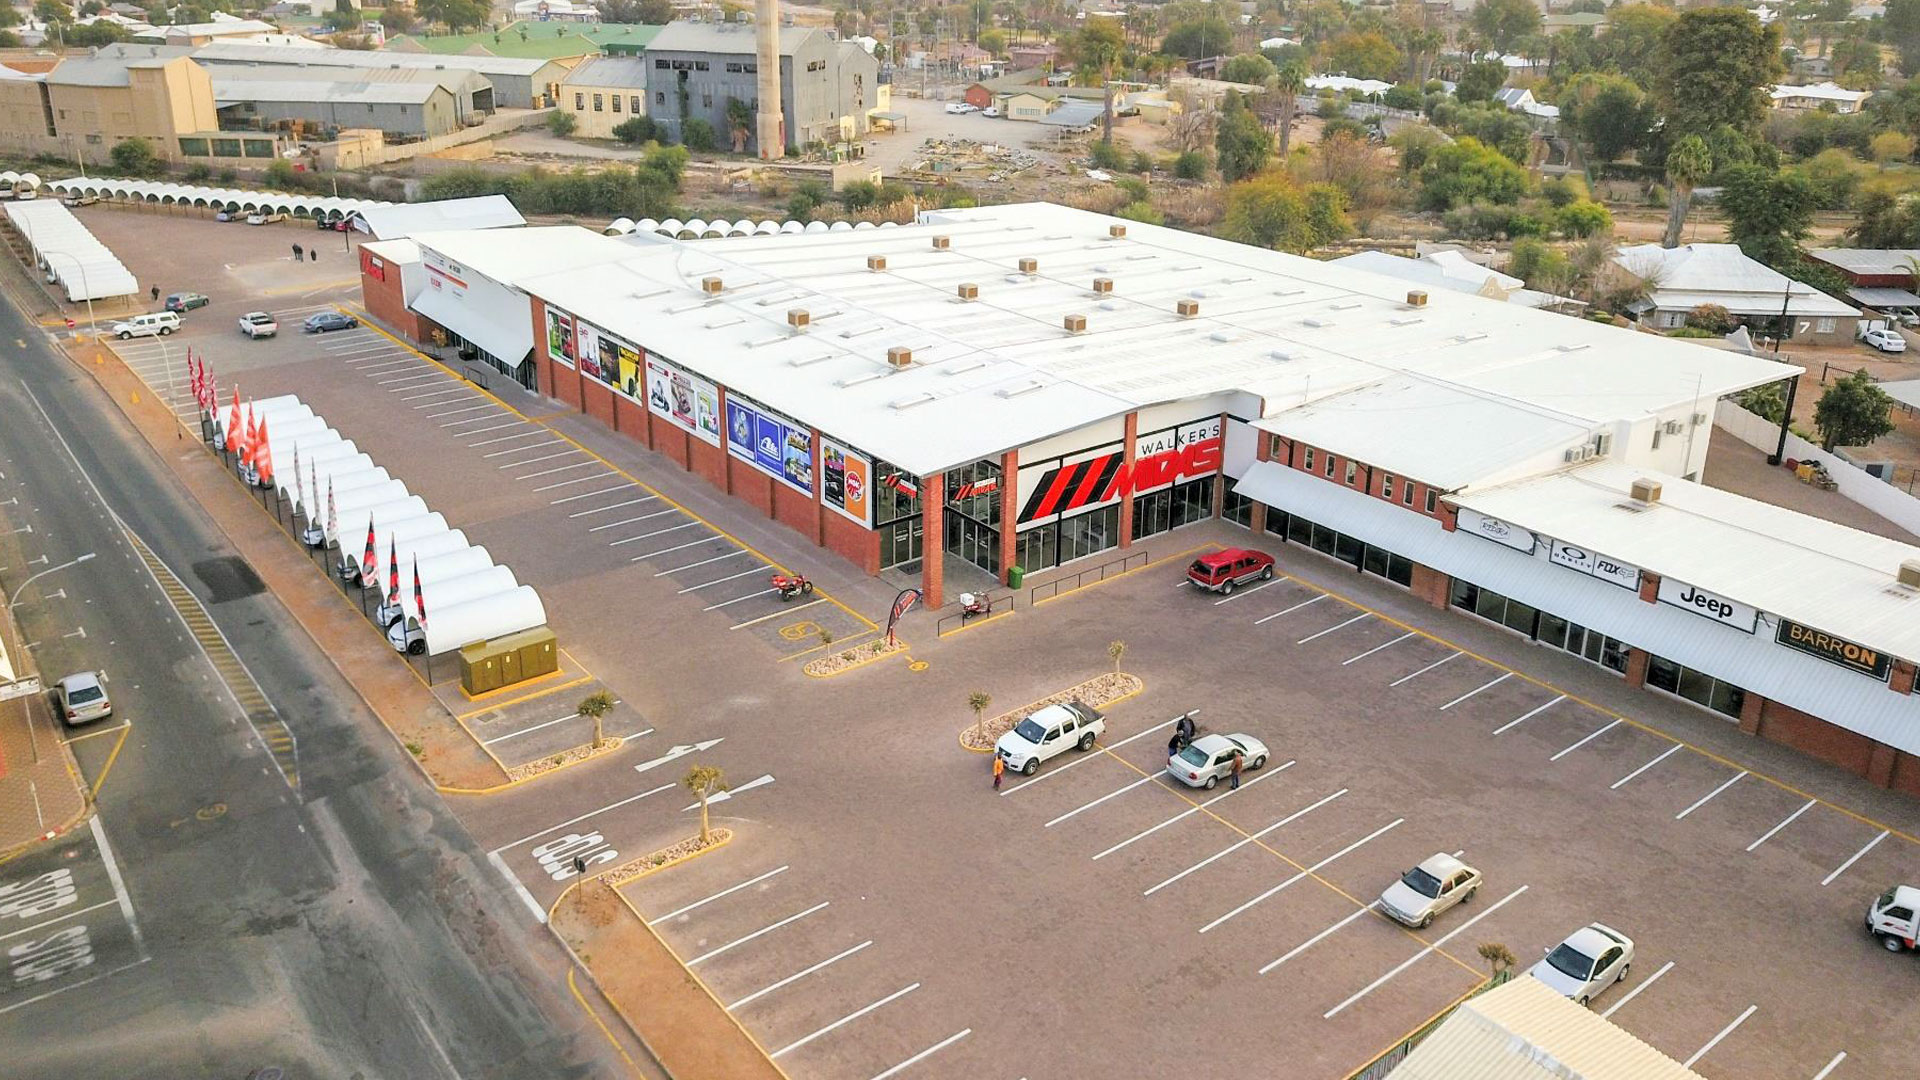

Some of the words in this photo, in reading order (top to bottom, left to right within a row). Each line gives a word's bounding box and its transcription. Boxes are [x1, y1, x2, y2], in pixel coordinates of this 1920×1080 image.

[1800, 321, 1811, 334] 7
[1142, 425, 1219, 455] WALKER'S
[1100, 437, 1221, 502] MIDAS
[1597, 560, 1621, 576] FOX
[1680, 587, 1733, 618] Jeep
[1790, 624, 1878, 667] BARRON
